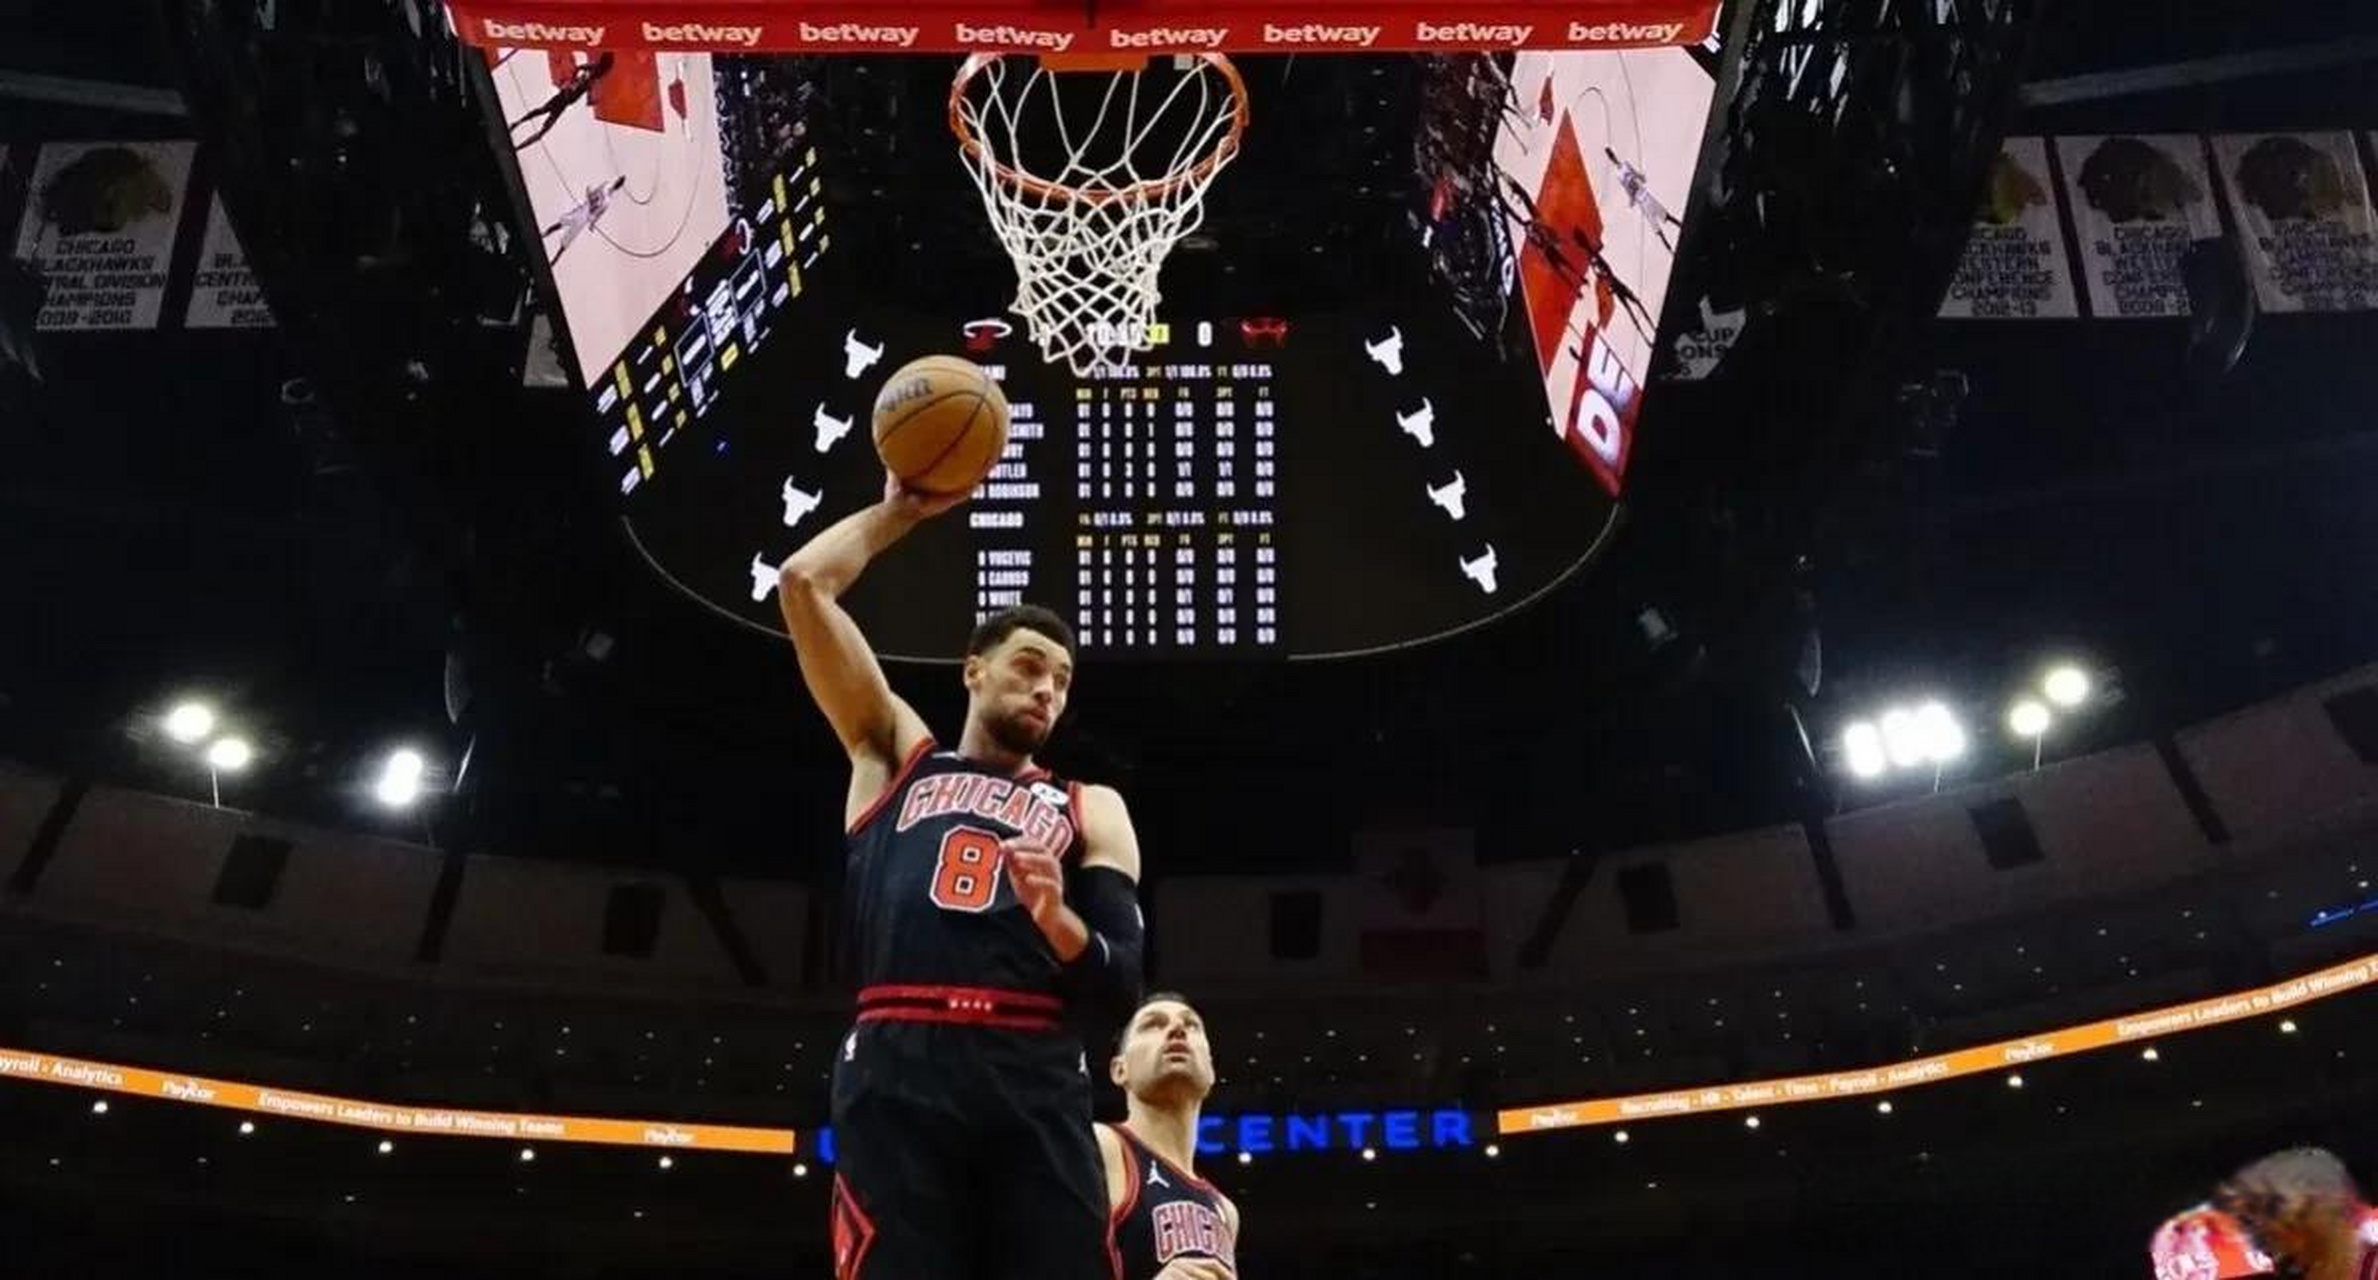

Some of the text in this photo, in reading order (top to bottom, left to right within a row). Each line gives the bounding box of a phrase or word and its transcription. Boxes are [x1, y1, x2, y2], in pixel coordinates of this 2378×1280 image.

[483, 19, 605, 46] betway
[642, 22, 762, 46] betway
[799, 22, 919, 46] betway
[955, 23, 1074, 51] betway
[1110, 26, 1229, 48] betway
[1263, 23, 1380, 45] betway
[1416, 22, 1533, 46] betway
[1567, 22, 1683, 42] betway
[57, 239, 135, 254] CHICAGO
[94, 274, 166, 289] DIVISION
[1948, 271, 2054, 285] ONFERENCE
[1197, 320, 1212, 347] 0
[1690, 328, 1733, 343] CUP
[969, 512, 1024, 529] CHICAGO
[988, 550, 1032, 567] VUCEVIC
[988, 570, 1031, 588] CARUSO
[988, 590, 1023, 608] WHITE
[896, 773, 1074, 859] CHICAGO
[929, 825, 1004, 913] 8
[2116, 966, 2369, 1037] Empowers Leaders to Build Winning
[0, 1055, 123, 1085] yroll Analytics
[1619, 1095, 1690, 1114] Recruiting
[1829, 1072, 1877, 1092] Payroll
[1888, 1060, 1949, 1083] Analytics
[257, 1092, 334, 1116] Empowers
[336, 1103, 393, 1125] Leaders
[395, 1107, 411, 1125] to
[414, 1108, 453, 1129] Build
[454, 1114, 516, 1133] Winning
[1197, 1110, 1474, 1153] CENTER
[1151, 1200, 1230, 1265] CHIC
